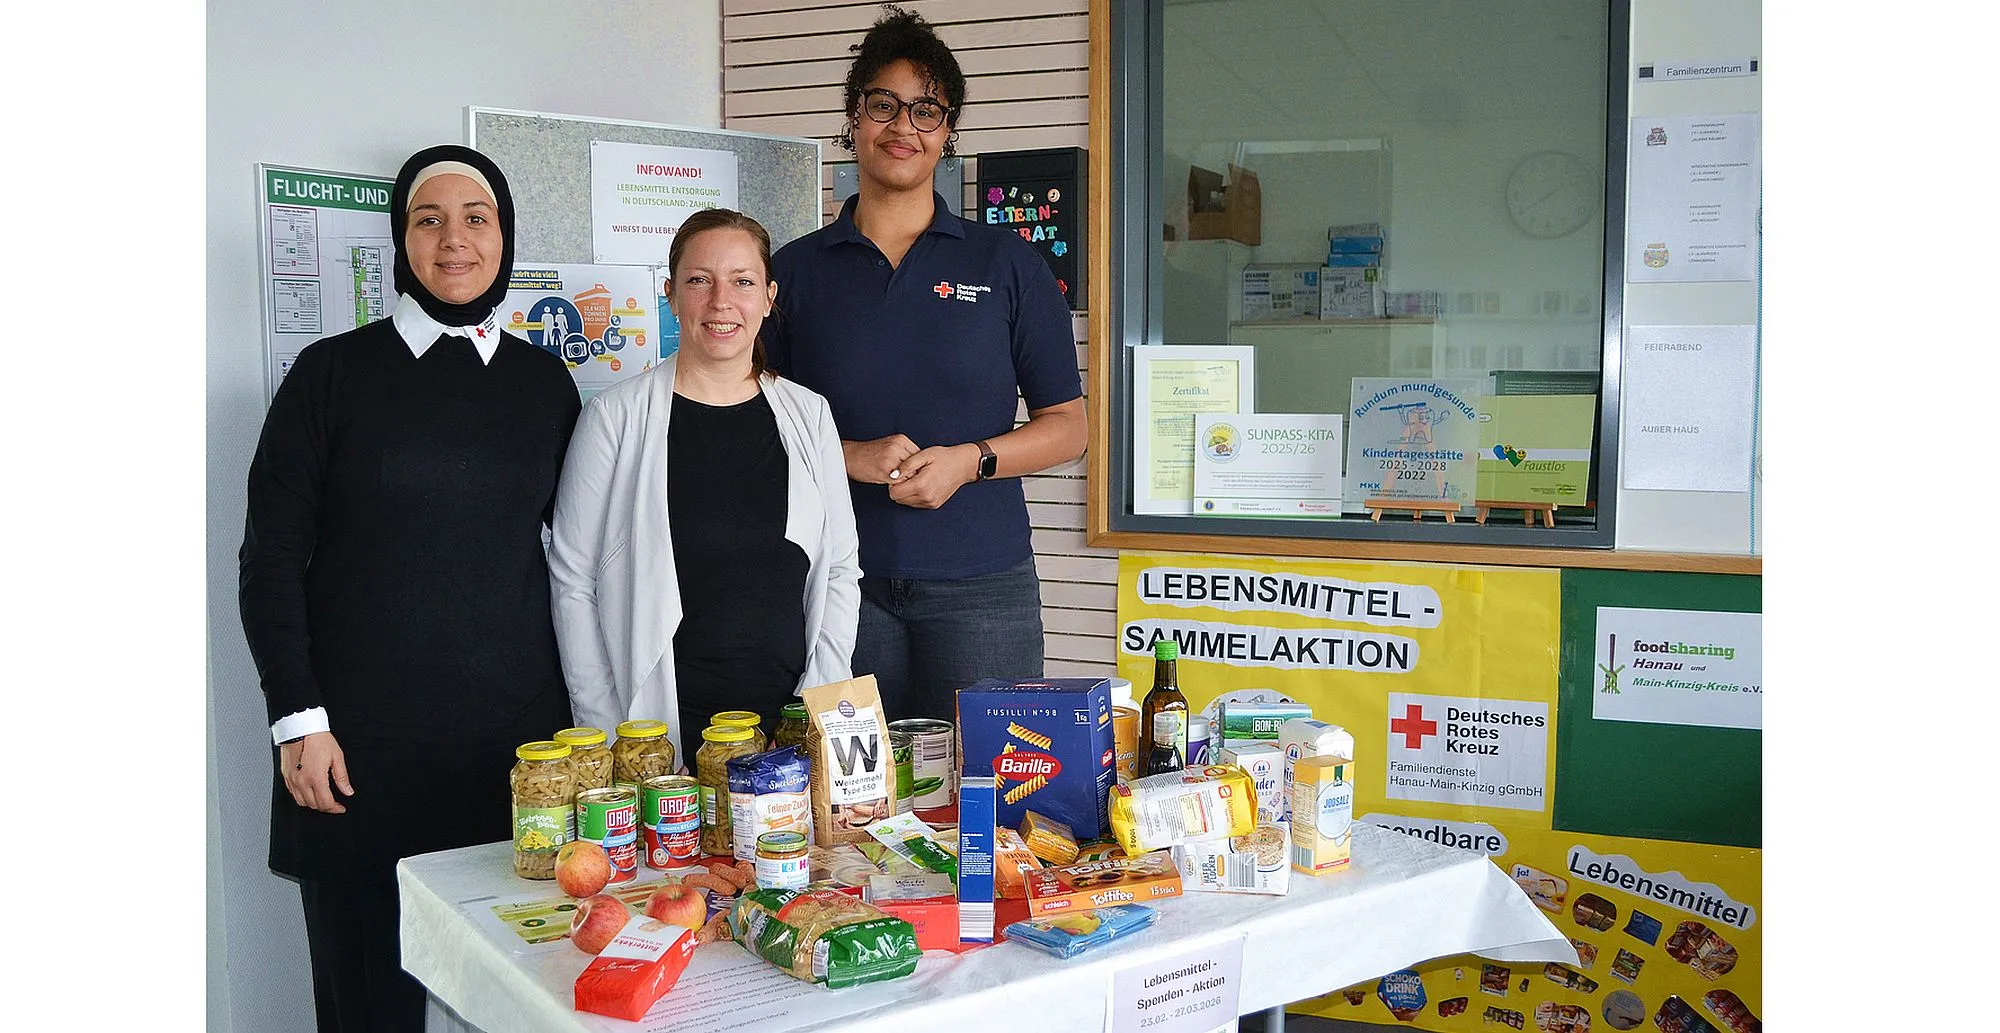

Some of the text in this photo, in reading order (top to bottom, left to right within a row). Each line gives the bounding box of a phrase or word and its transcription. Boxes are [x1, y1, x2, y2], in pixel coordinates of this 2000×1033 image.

[1666, 65, 1742, 77] Familienzentrum
[636, 164, 702, 178] INFOWAND!
[273, 178, 389, 206] FLUCHT- UND
[617, 184, 721, 196] LEBENSMITTEL ENTSORGUNG
[633, 198, 688, 207] DEUTSCHLAND:
[613, 225, 640, 233] WIRFST
[642, 226, 653, 234] DU
[1019, 225, 1058, 242] RAT
[1644, 343, 1702, 351] FEIERABEND
[1172, 386, 1209, 395] Zertifikat
[1354, 386, 1399, 418] Rundum
[1401, 383, 1475, 421] mundgesunde
[1247, 429, 1335, 441] SUNPASS-KITA
[1673, 425, 1699, 434] HAUS
[1261, 443, 1316, 456] 2025/26
[1362, 447, 1464, 461] Kindertagesstätte
[1379, 460, 1408, 470] 2025
[1418, 461, 1447, 471] 2028
[1523, 460, 1566, 472] Faustlos
[1397, 470, 1426, 480] 2022
[1143, 572, 1411, 619] LEBENSMITTEL
[1125, 625, 1409, 670] SAMMELAKTION
[1633, 640, 1735, 660] foodsharing
[1633, 658, 1683, 671] Hanau
[1632, 677, 1739, 692] Main-Kinzig-Kreis
[1447, 707, 1545, 727] Deutsches
[1447, 723, 1499, 739] Rotes
[1446, 739, 1499, 755] Kreuz
[831, 733, 878, 776] W
[1001, 758, 1051, 774] Barilla
[1390, 761, 1476, 777] Familiendienste
[834, 773, 883, 787] Weizenmehl
[1255, 778, 1275, 790] uder
[1390, 775, 1543, 797] Hanau-Main-Kinzig gGmbH
[842, 783, 876, 796] Type 550
[1323, 794, 1350, 808] JODSALZ
[767, 803, 792, 814] Feiner
[1202, 863, 1210, 883] HAFER
[1208, 855, 1217, 884] FLOCKEN
[1517, 868, 1529, 877] jo!
[1090, 886, 1176, 906] Toffifee 15 Stück
[1569, 852, 1749, 927] Lebensmittel
[1044, 900, 1069, 910] schleich
[1144, 959, 1211, 989] Lebensmittel
[1384, 974, 1421, 984] SCHOKO
[1137, 989, 1184, 1010] Spenden
[1192, 975, 1226, 994] Aktion
[1386, 982, 1420, 995] DRINK
[1140, 1013, 1168, 1028] 23.02.
[1174, 996, 1221, 1018] 27.03.2026
